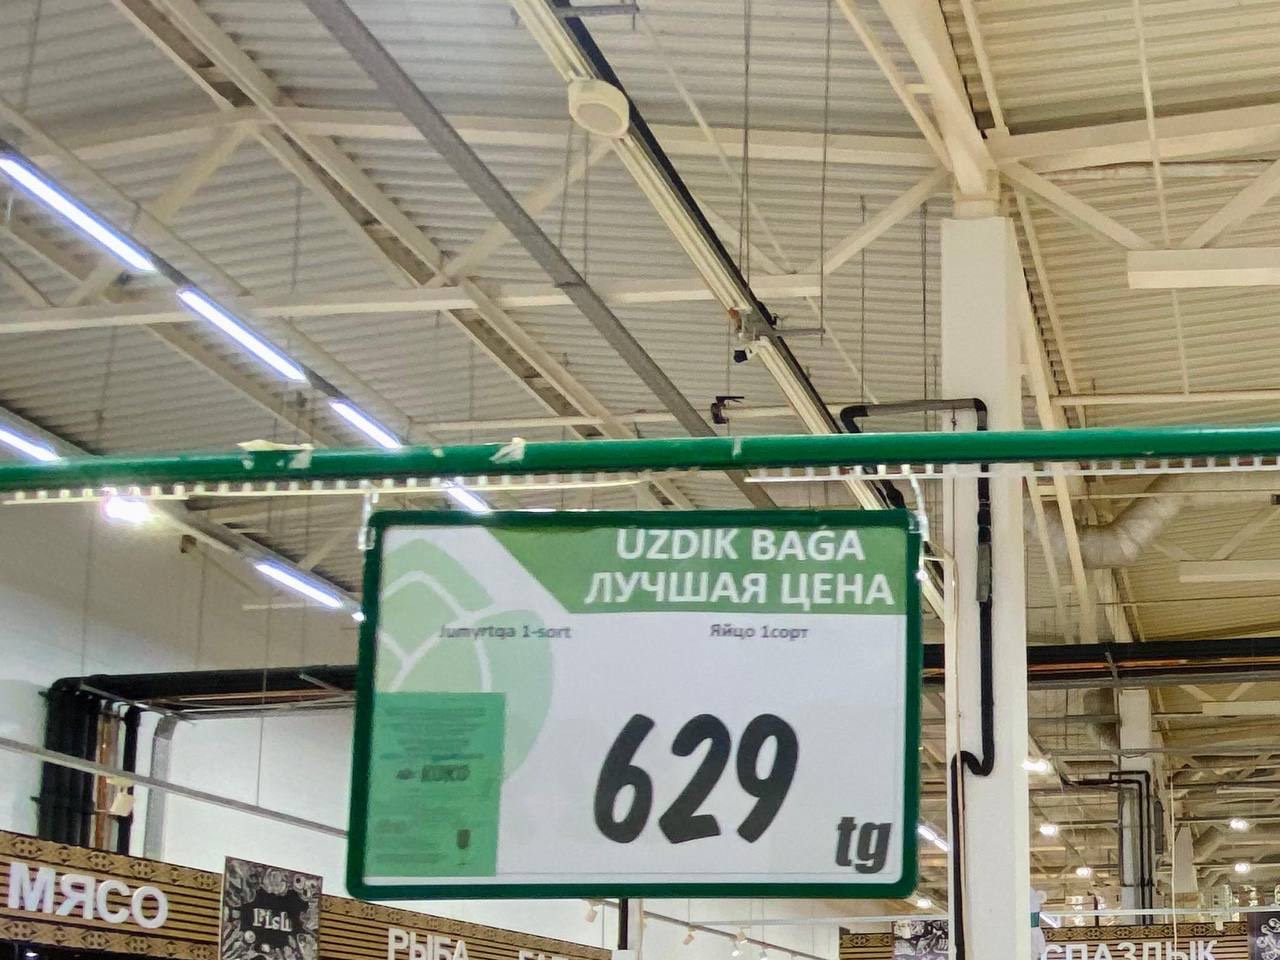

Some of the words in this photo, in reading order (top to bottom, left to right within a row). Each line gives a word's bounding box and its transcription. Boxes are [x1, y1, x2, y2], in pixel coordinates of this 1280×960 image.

[584, 571, 768, 604] ЛУЧШАЯ
[780, 573, 896, 612] ЦЕНА
[522, 624, 573, 639] 1-sort
[710, 623, 756, 640] Яйцо
[761, 624, 809, 641] 1сорт
[593, 713, 800, 845] 629
[836, 815, 892, 875] tg
[7, 862, 169, 930] МЯСО
[252, 908, 293, 933] Fish
